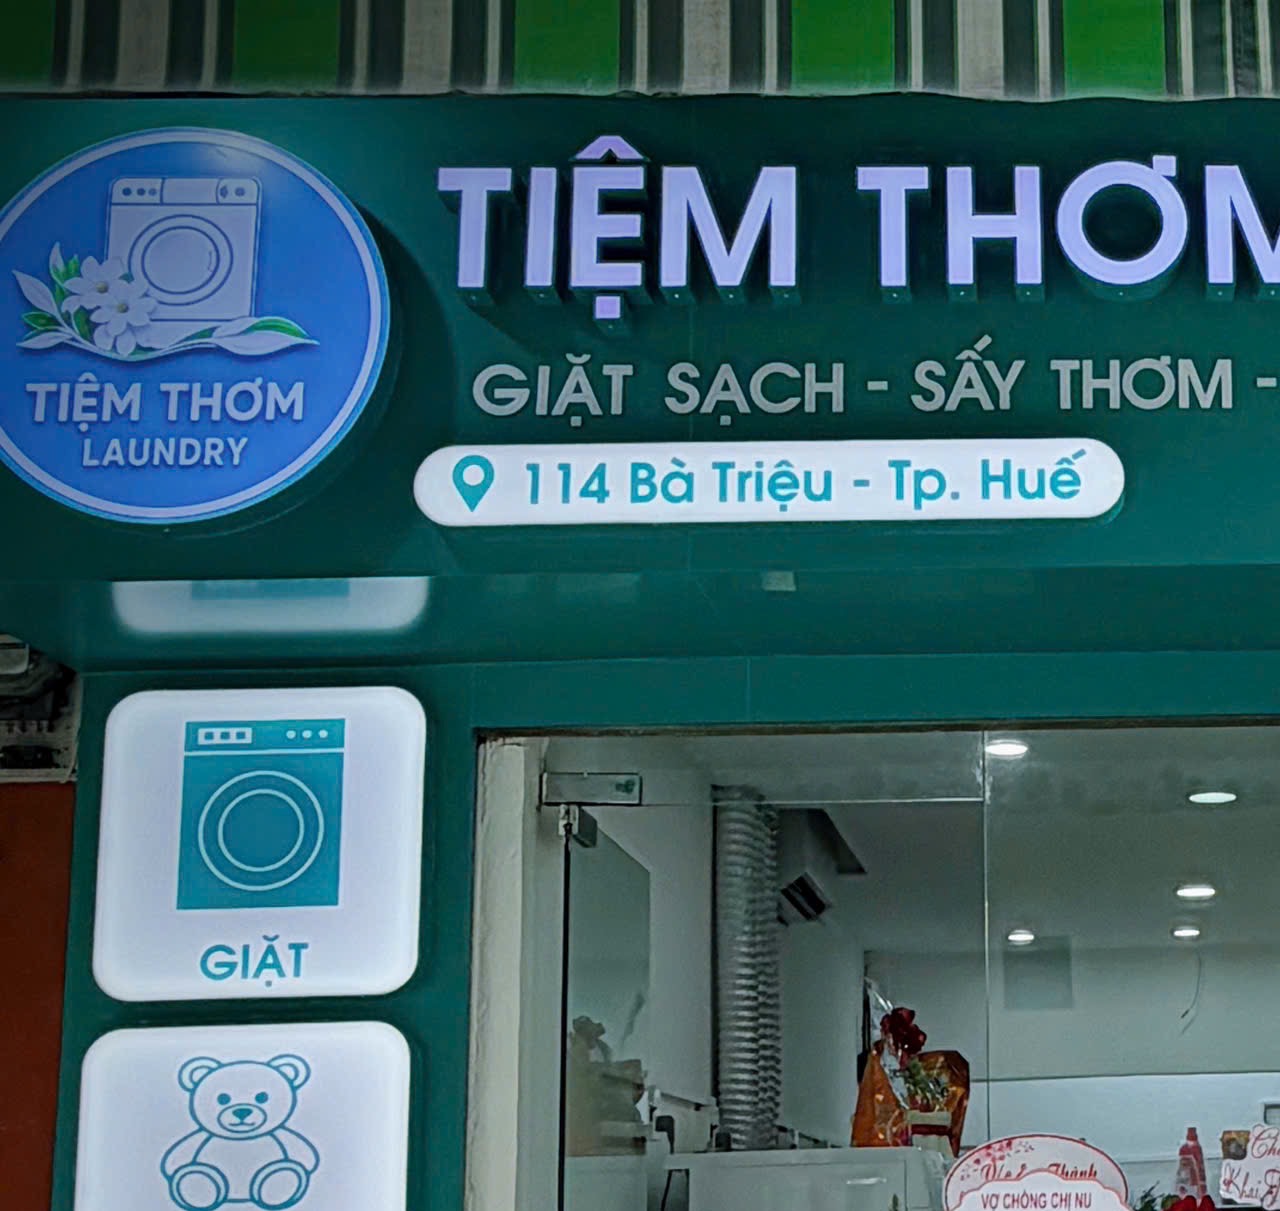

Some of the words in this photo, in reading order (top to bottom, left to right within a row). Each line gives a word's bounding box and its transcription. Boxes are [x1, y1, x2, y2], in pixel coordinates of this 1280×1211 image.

[437, 135, 796, 319] TIỆM
[26, 371, 141, 431] TIỆM
[160, 377, 304, 422] THƠM
[472, 353, 633, 426] GIẶT
[664, 362, 844, 426] SẠCH
[910, 334, 1025, 412] SẤY
[1050, 356, 1233, 409] THƠM
[82, 437, 249, 467] LAUNDRY
[525, 461, 610, 505] 114
[630, 457, 694, 503] Bà
[712, 460, 832, 512] Triệu
[888, 459, 960, 510] Tp.
[980, 448, 1087, 500] Huế
[200, 934, 309, 987] GIẶT
[1051, 1192, 1071, 1211] CHỊ
